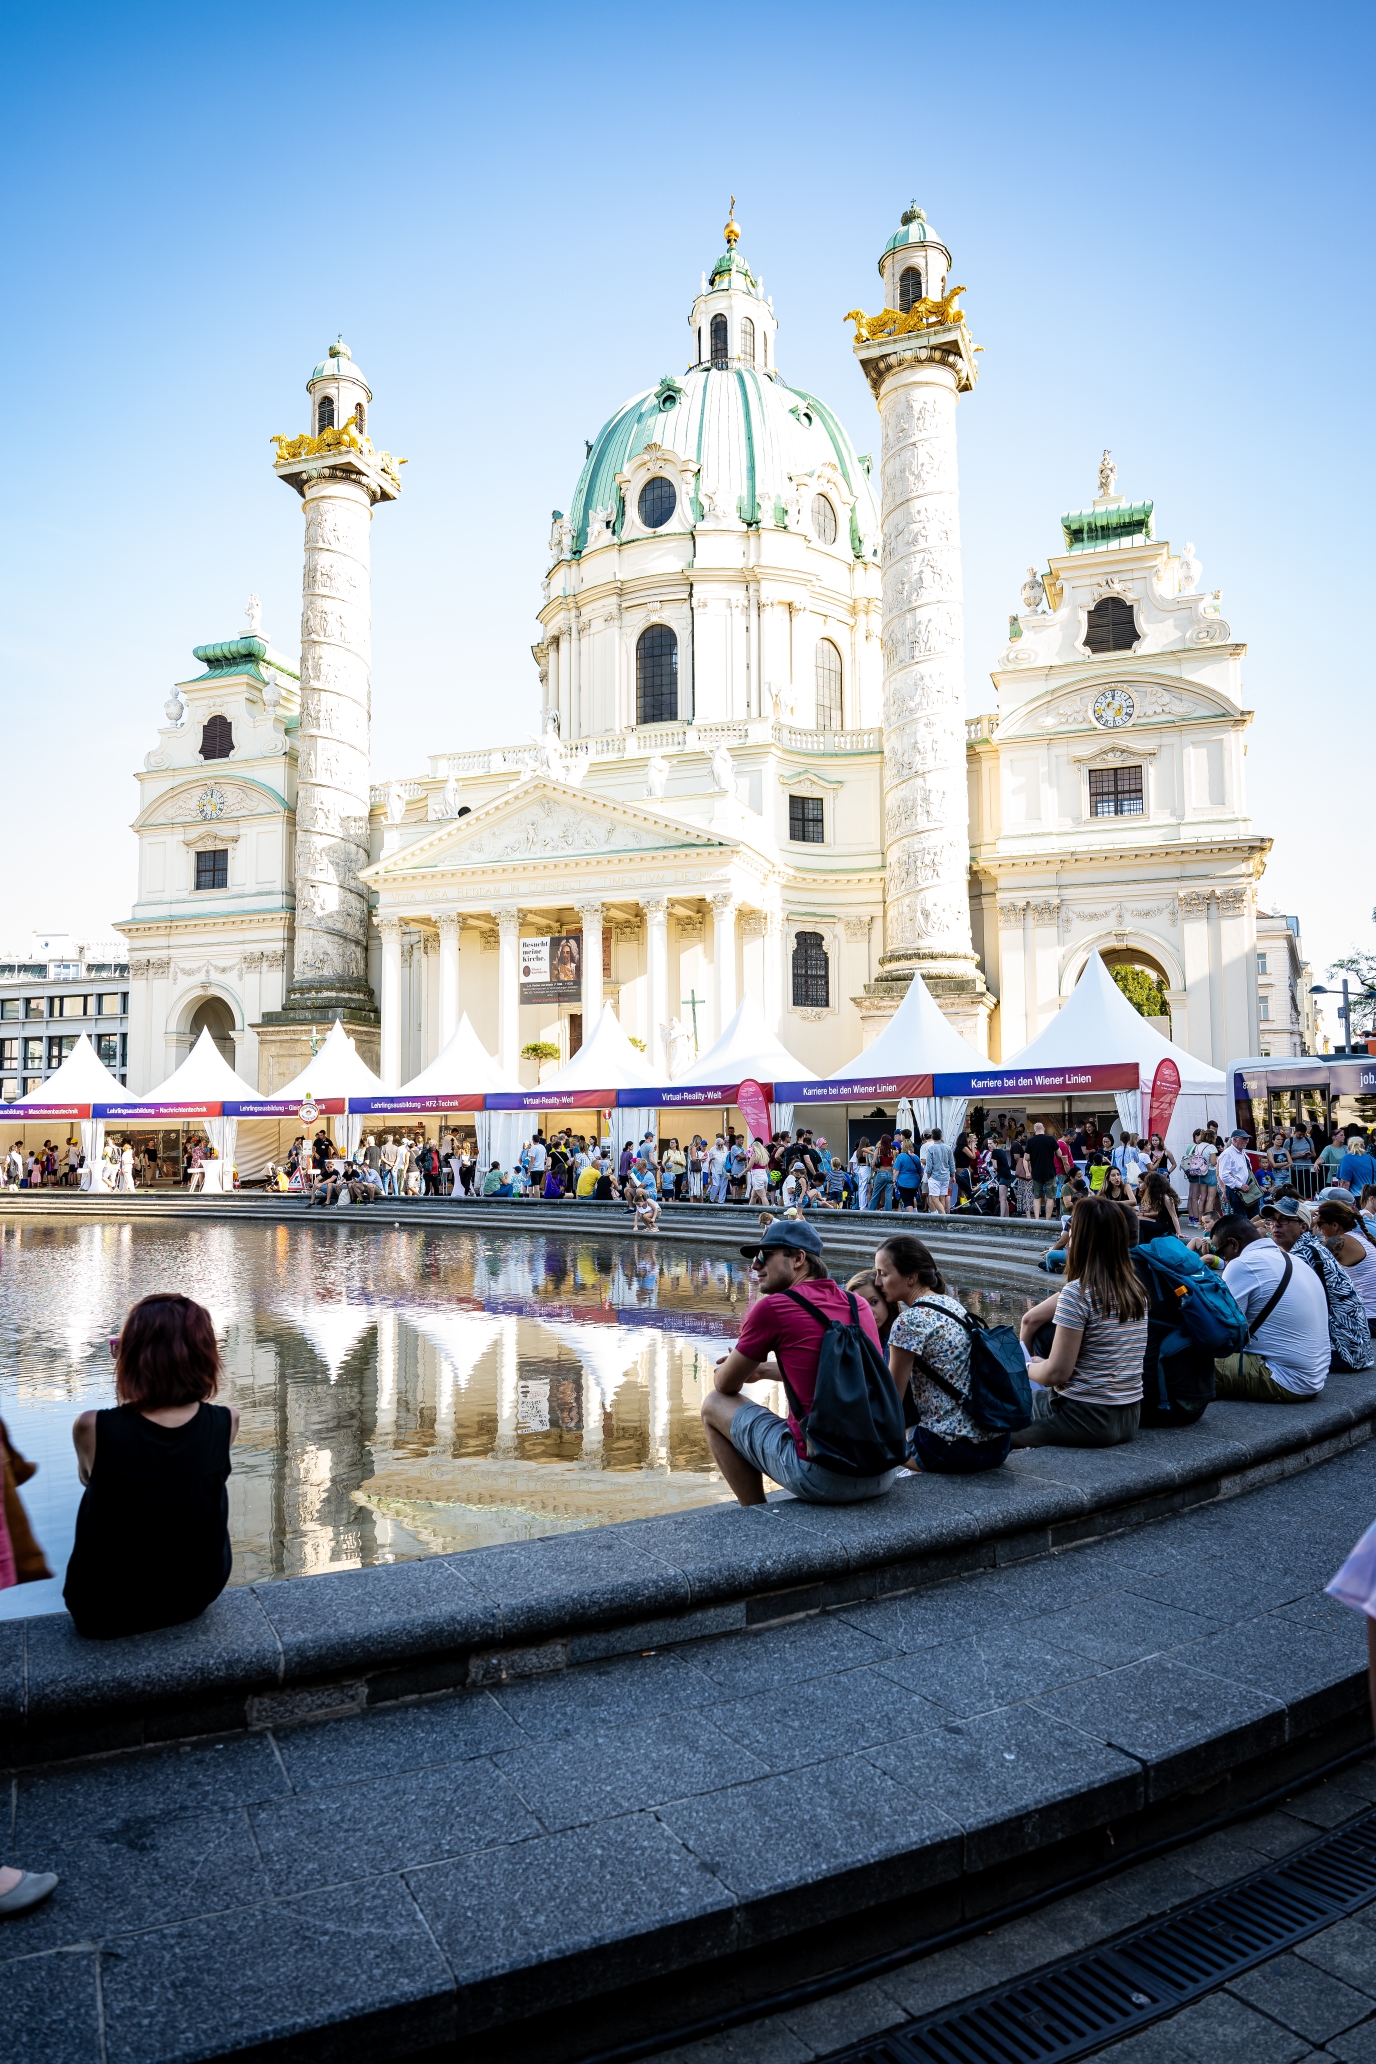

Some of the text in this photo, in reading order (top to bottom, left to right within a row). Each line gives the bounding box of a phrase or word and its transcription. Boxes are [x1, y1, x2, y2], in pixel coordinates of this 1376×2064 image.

[390, 892, 416, 902] VOTA
[424, 890, 448, 900] MEA
[456, 886, 501, 898] REDDAM
[971, 1074, 1092, 1088] Karriere bei den Wiener Linien
[662, 1091, 722, 1101] Virtual-Reality-Welt
[803, 1084, 897, 1096] Karriere bei den Wiener Linien
[523, 1096, 574, 1104] Virtual-Reality-Welt
